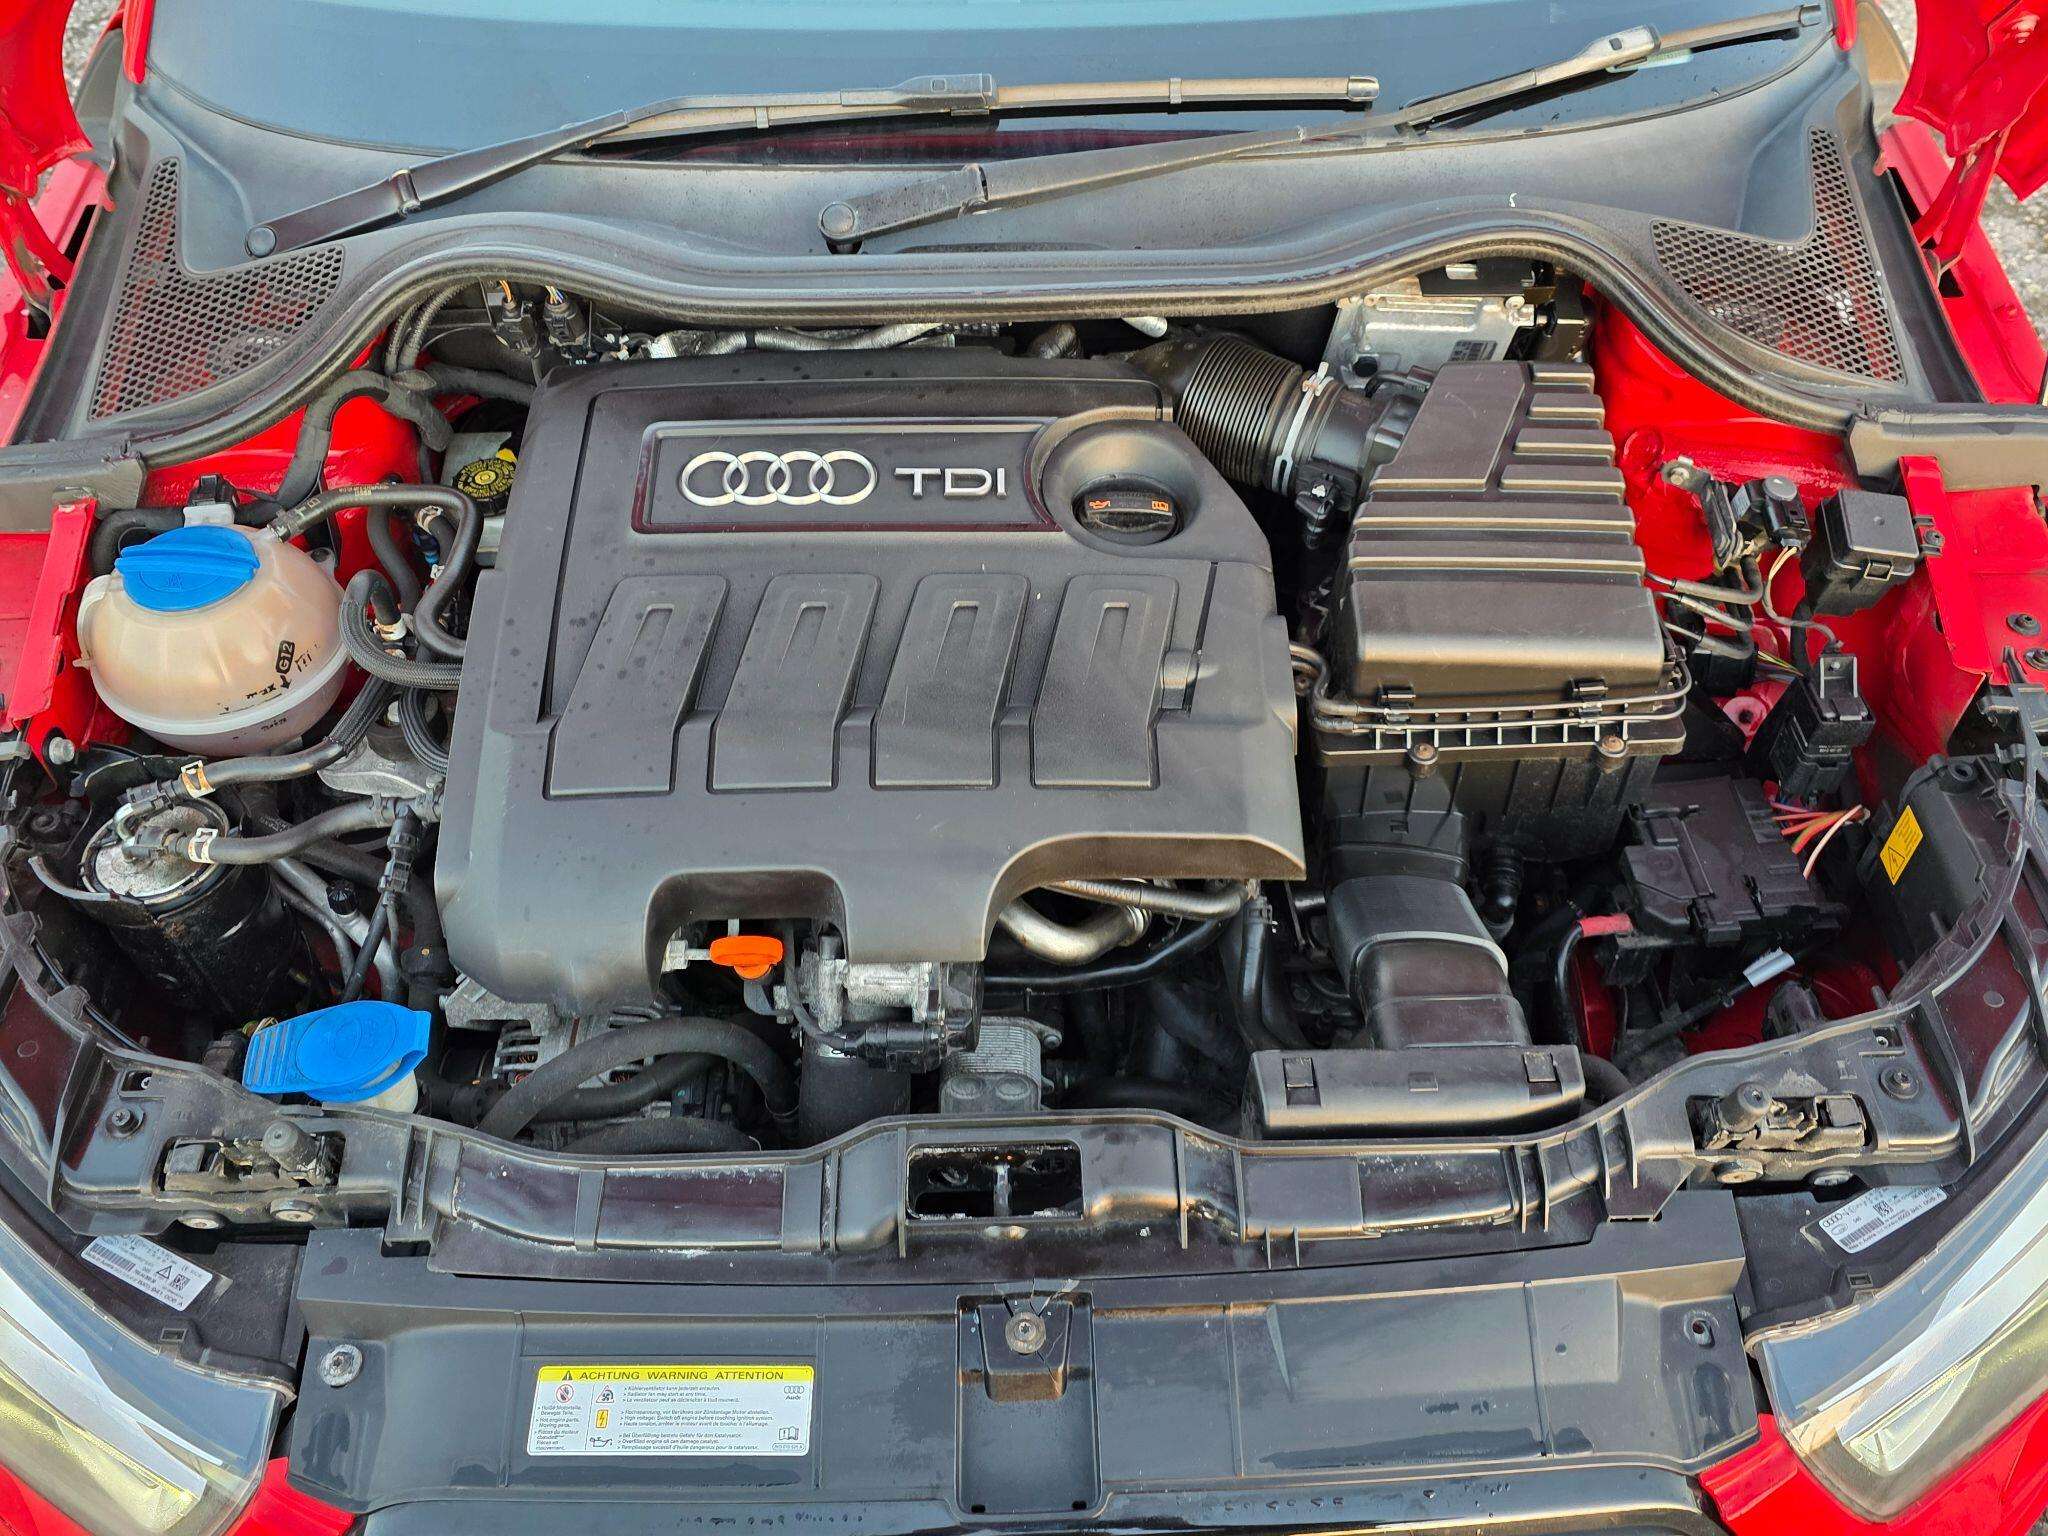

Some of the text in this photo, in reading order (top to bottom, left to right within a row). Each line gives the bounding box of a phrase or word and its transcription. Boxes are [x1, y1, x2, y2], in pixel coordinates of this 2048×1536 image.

[894, 467, 1007, 497] TDI
[278, 642, 295, 671] G12
[580, 1371, 784, 1380] ACHTUNG WARNING ATTENTION
